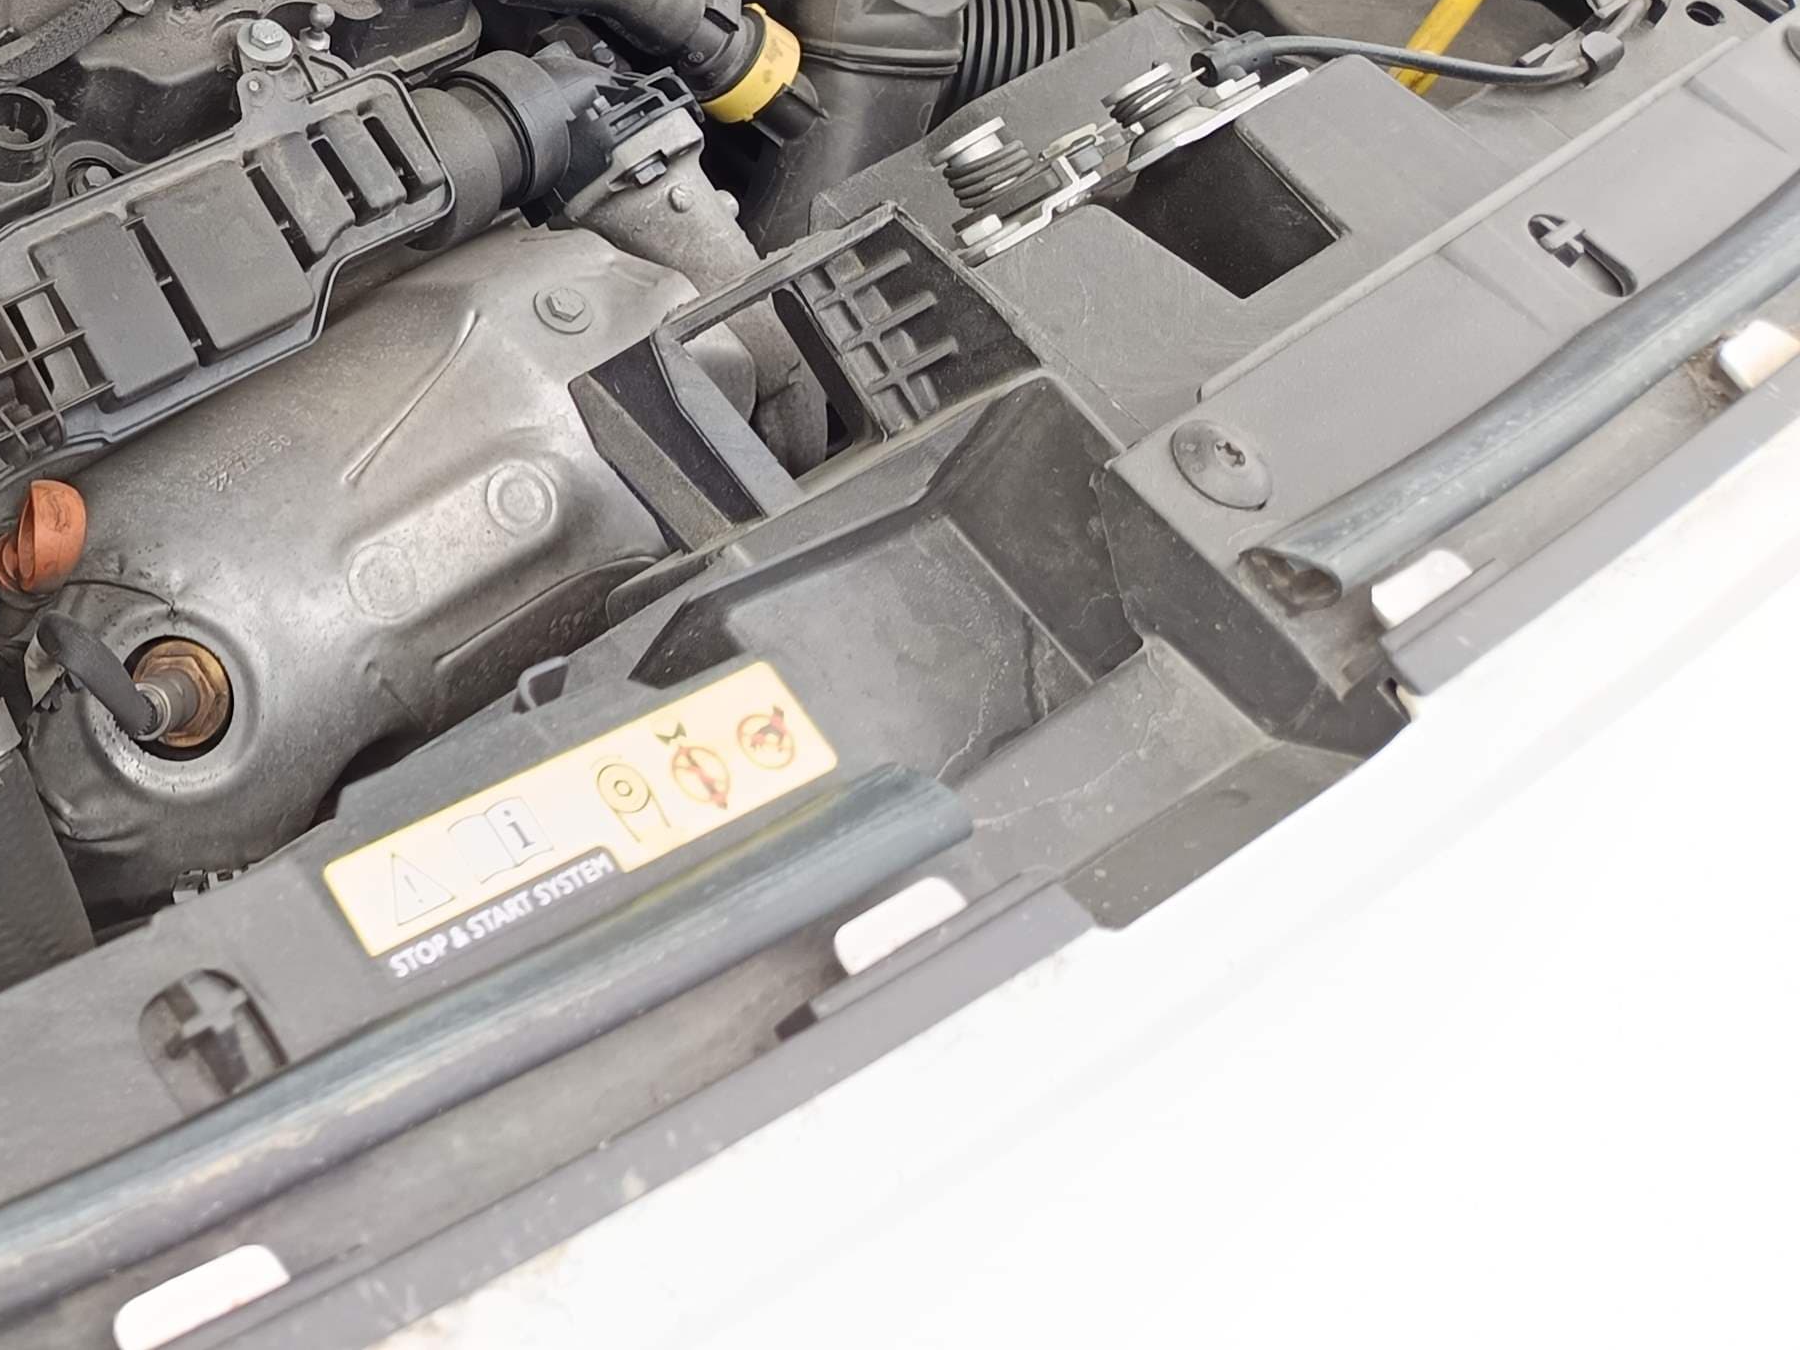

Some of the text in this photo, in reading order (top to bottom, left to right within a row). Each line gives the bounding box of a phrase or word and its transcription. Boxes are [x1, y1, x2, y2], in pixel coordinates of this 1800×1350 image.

[389, 852, 615, 978] STOP & START SYSTEM
